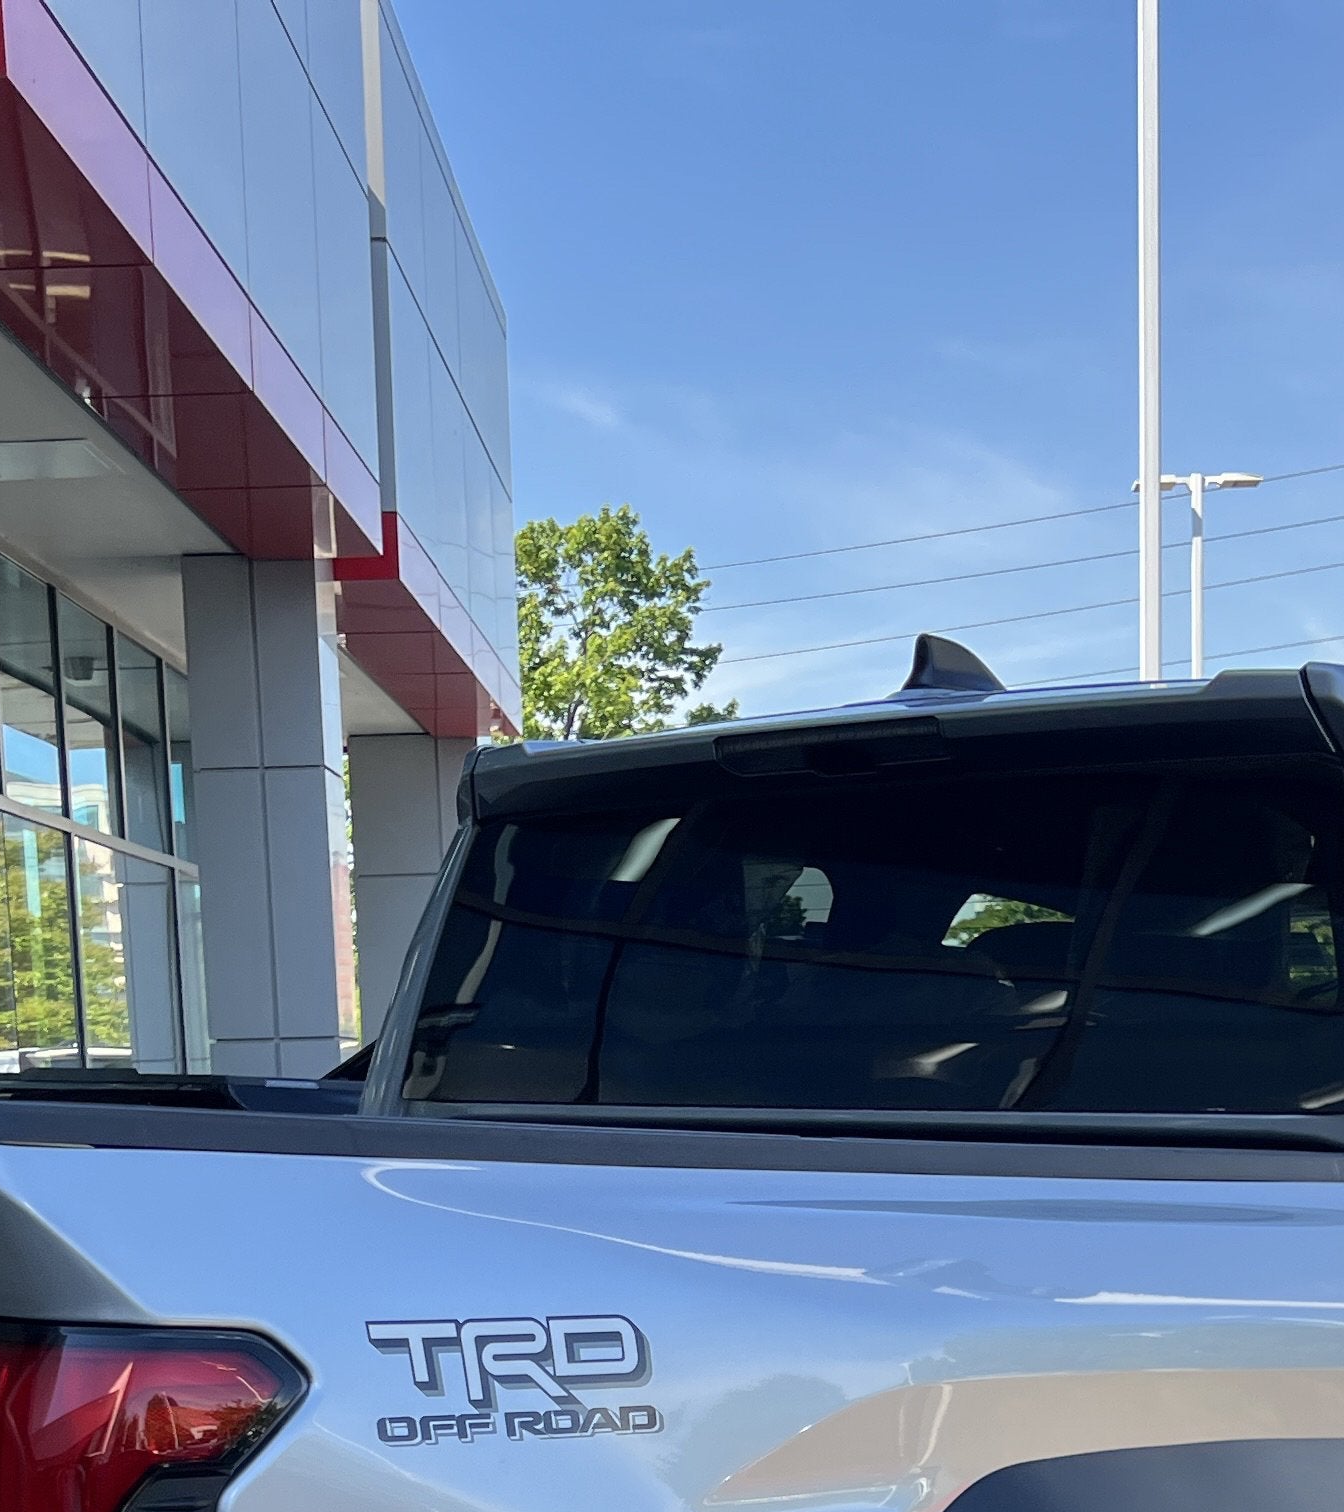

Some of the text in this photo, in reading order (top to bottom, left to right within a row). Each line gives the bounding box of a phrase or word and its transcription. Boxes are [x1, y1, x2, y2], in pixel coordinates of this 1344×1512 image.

[365, 1314, 653, 1414] TRD
[377, 1404, 666, 1446] OFF ROAD
